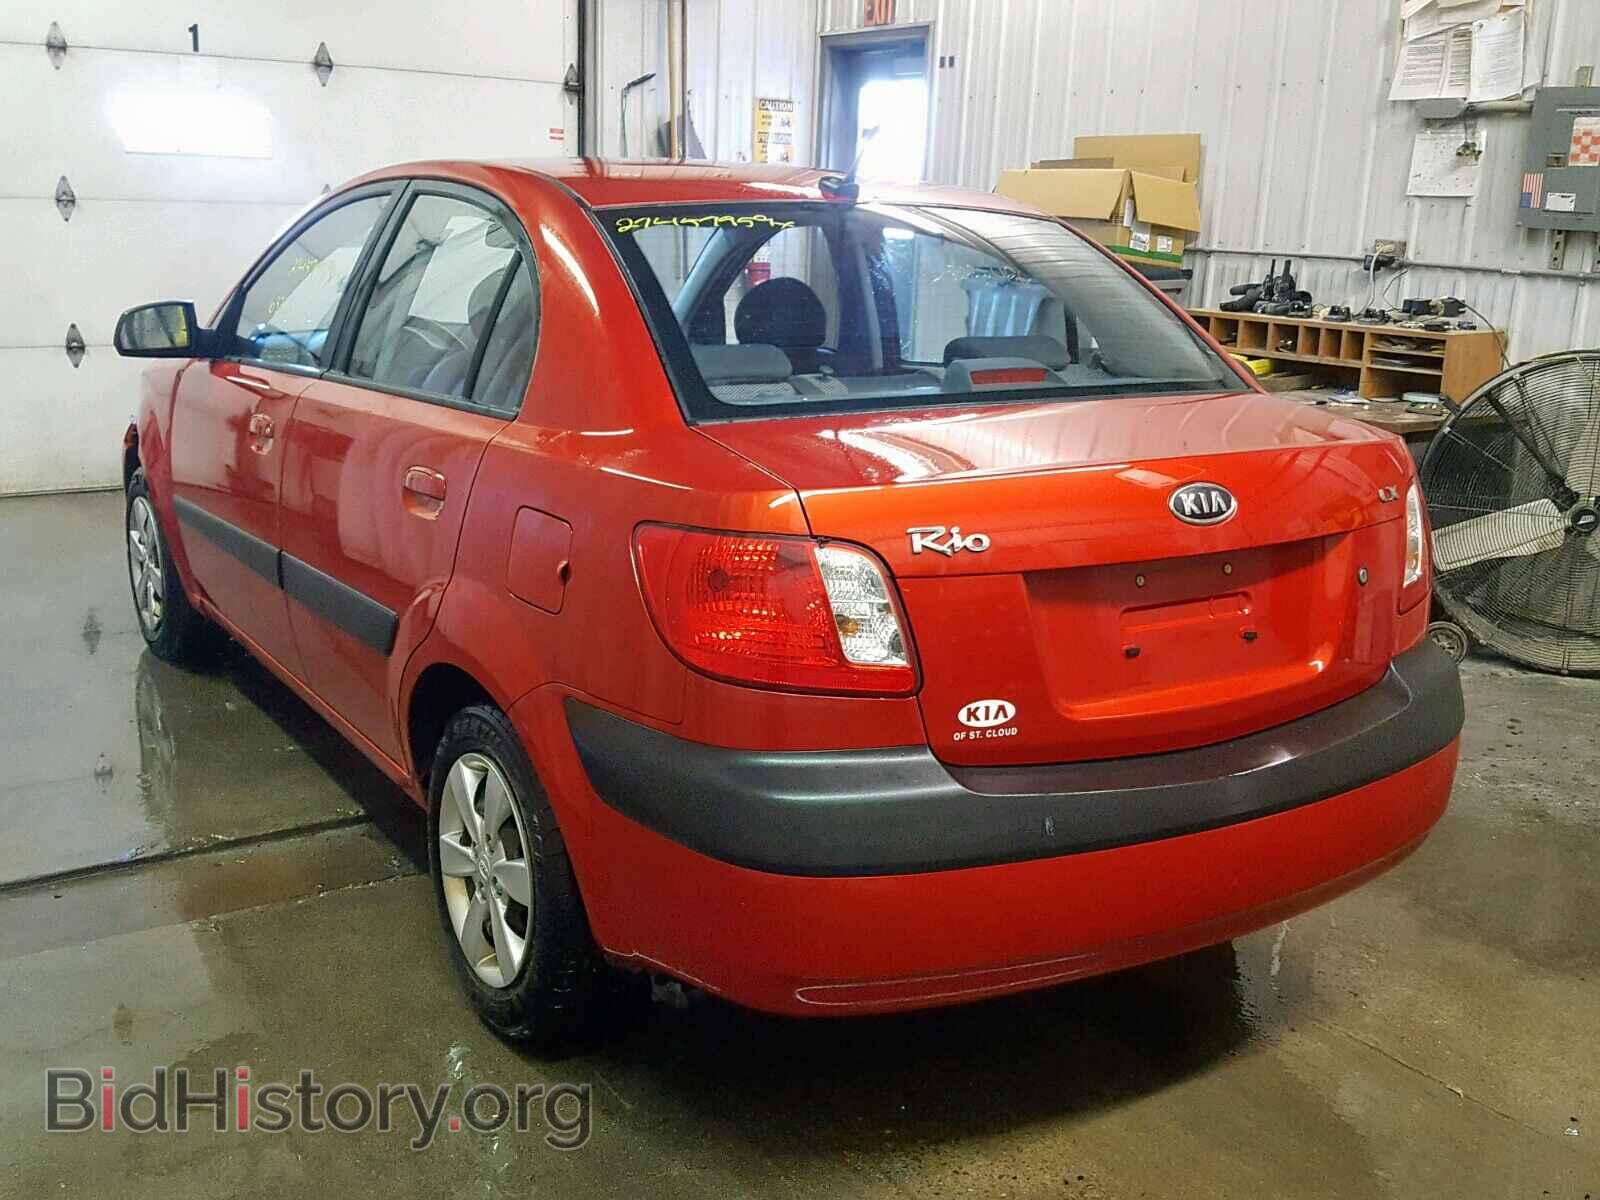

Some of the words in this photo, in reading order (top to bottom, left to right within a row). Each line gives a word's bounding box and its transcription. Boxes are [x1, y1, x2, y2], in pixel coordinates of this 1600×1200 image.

[188, 23, 199, 52] 1
[759, 101, 793, 112] CAUTION
[1179, 490, 1228, 516] KIA
[906, 525, 991, 557] Rio
[966, 704, 1008, 722] KIA
[953, 732, 967, 741] OF
[969, 731, 983, 740] ST.
[985, 727, 1018, 738] CLOUD
